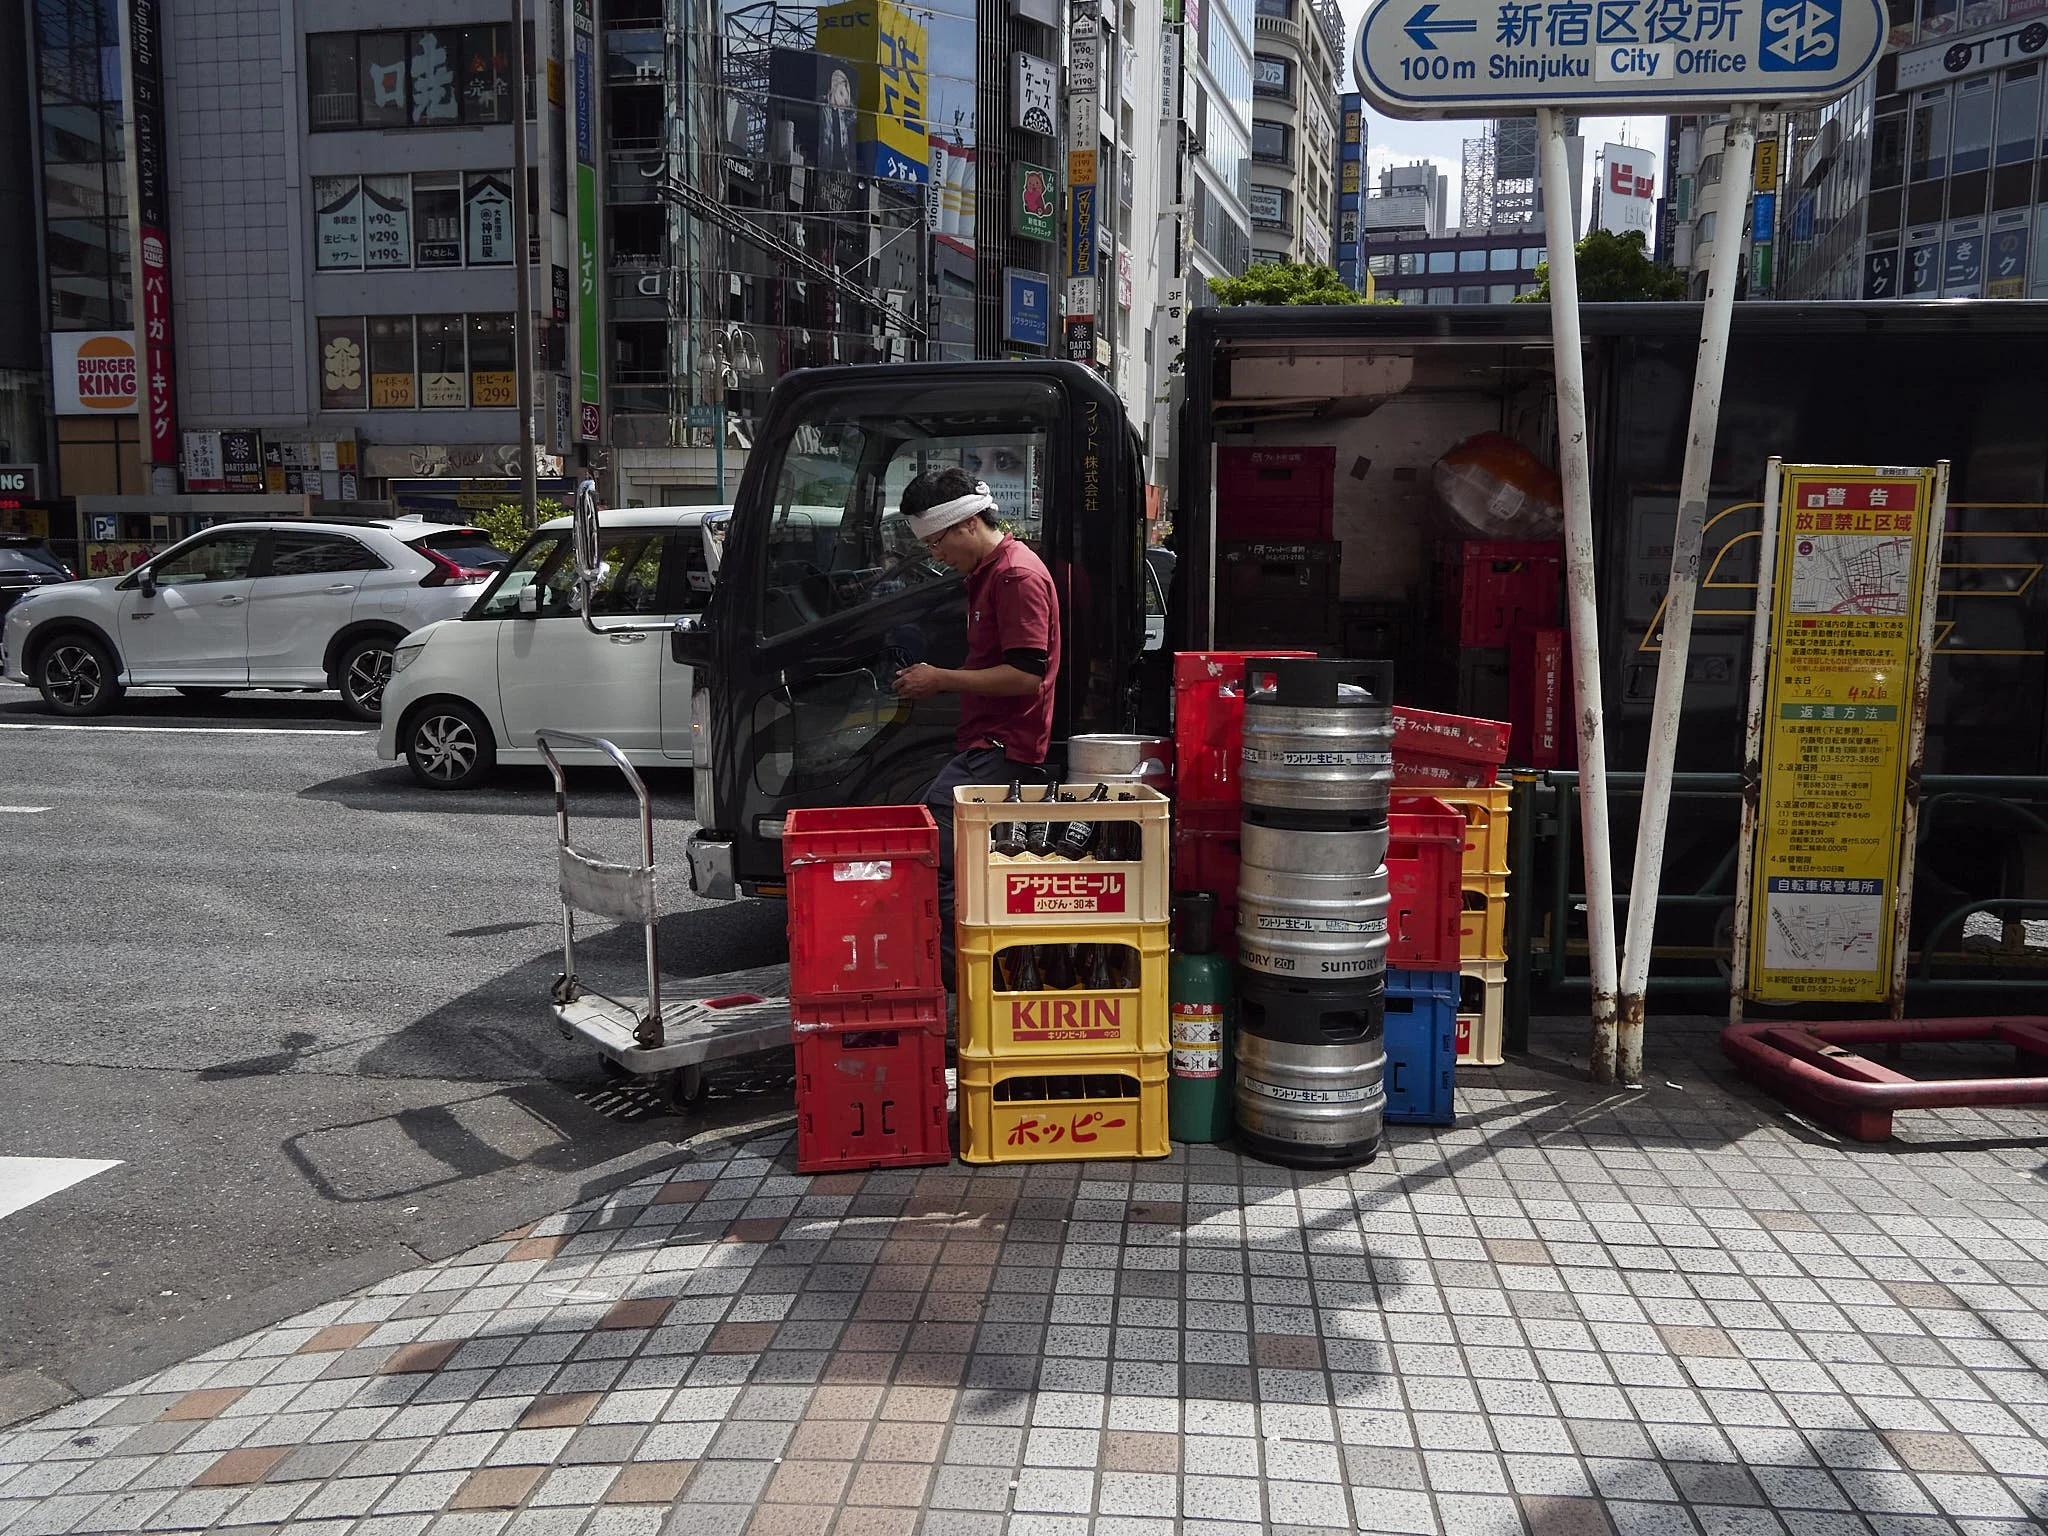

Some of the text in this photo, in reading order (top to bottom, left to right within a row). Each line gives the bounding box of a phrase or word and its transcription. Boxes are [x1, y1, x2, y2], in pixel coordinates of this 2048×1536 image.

[1496, 1, 1742, 47] 新宿区役所
[1400, 48, 1746, 83] 100m Shinjuku City Office
[1025, 72, 1051, 94] ダーツ
[1025, 88, 1052, 110] グッズ
[1761, 146, 1773, 185] プロミス
[324, 231, 399, 245] 生ビール ¥290
[1077, 190, 1090, 273] マツモトキヨシ
[481, 222, 493, 258] 神田屋
[331, 252, 358, 262] サワー
[424, 247, 455, 257] やきとん
[582, 243, 594, 295] レイク
[1168, 291, 1181, 300] 3F
[1069, 340, 1091, 350] DARTS
[146, 276, 170, 440] バーガーキング
[1073, 349, 1087, 359] BAR
[77, 357, 136, 374] BURGER
[78, 374, 137, 396] KING
[476, 375, 513, 386] 生ビール
[1083, 401, 1100, 511] フィット 株式会社
[225, 463, 258, 473] DARTS BAR
[1827, 488, 1888, 506] 警告
[1795, 512, 1912, 532] 放置禁止区域
[1784, 676, 1811, 685] 撤去日
[1800, 705, 1879, 719] 返還方法
[1286, 754, 1345, 764] サントリー生ビール
[1010, 876, 1121, 896] アサヒビール
[1777, 879, 1875, 893] 自転車保管場所
[1036, 899, 1095, 910] 小びん・30本
[1259, 918, 1312, 930] サントリー生ビール
[1321, 958, 1378, 973] SUNTORY
[1011, 998, 1121, 1030] KIRIN
[1183, 1004, 1213, 1015] 危険
[1047, 1031, 1087, 1039] キリンビール
[1272, 1087, 1329, 1101] サントリー生ビール
[1007, 1111, 1126, 1146] ホッピー
